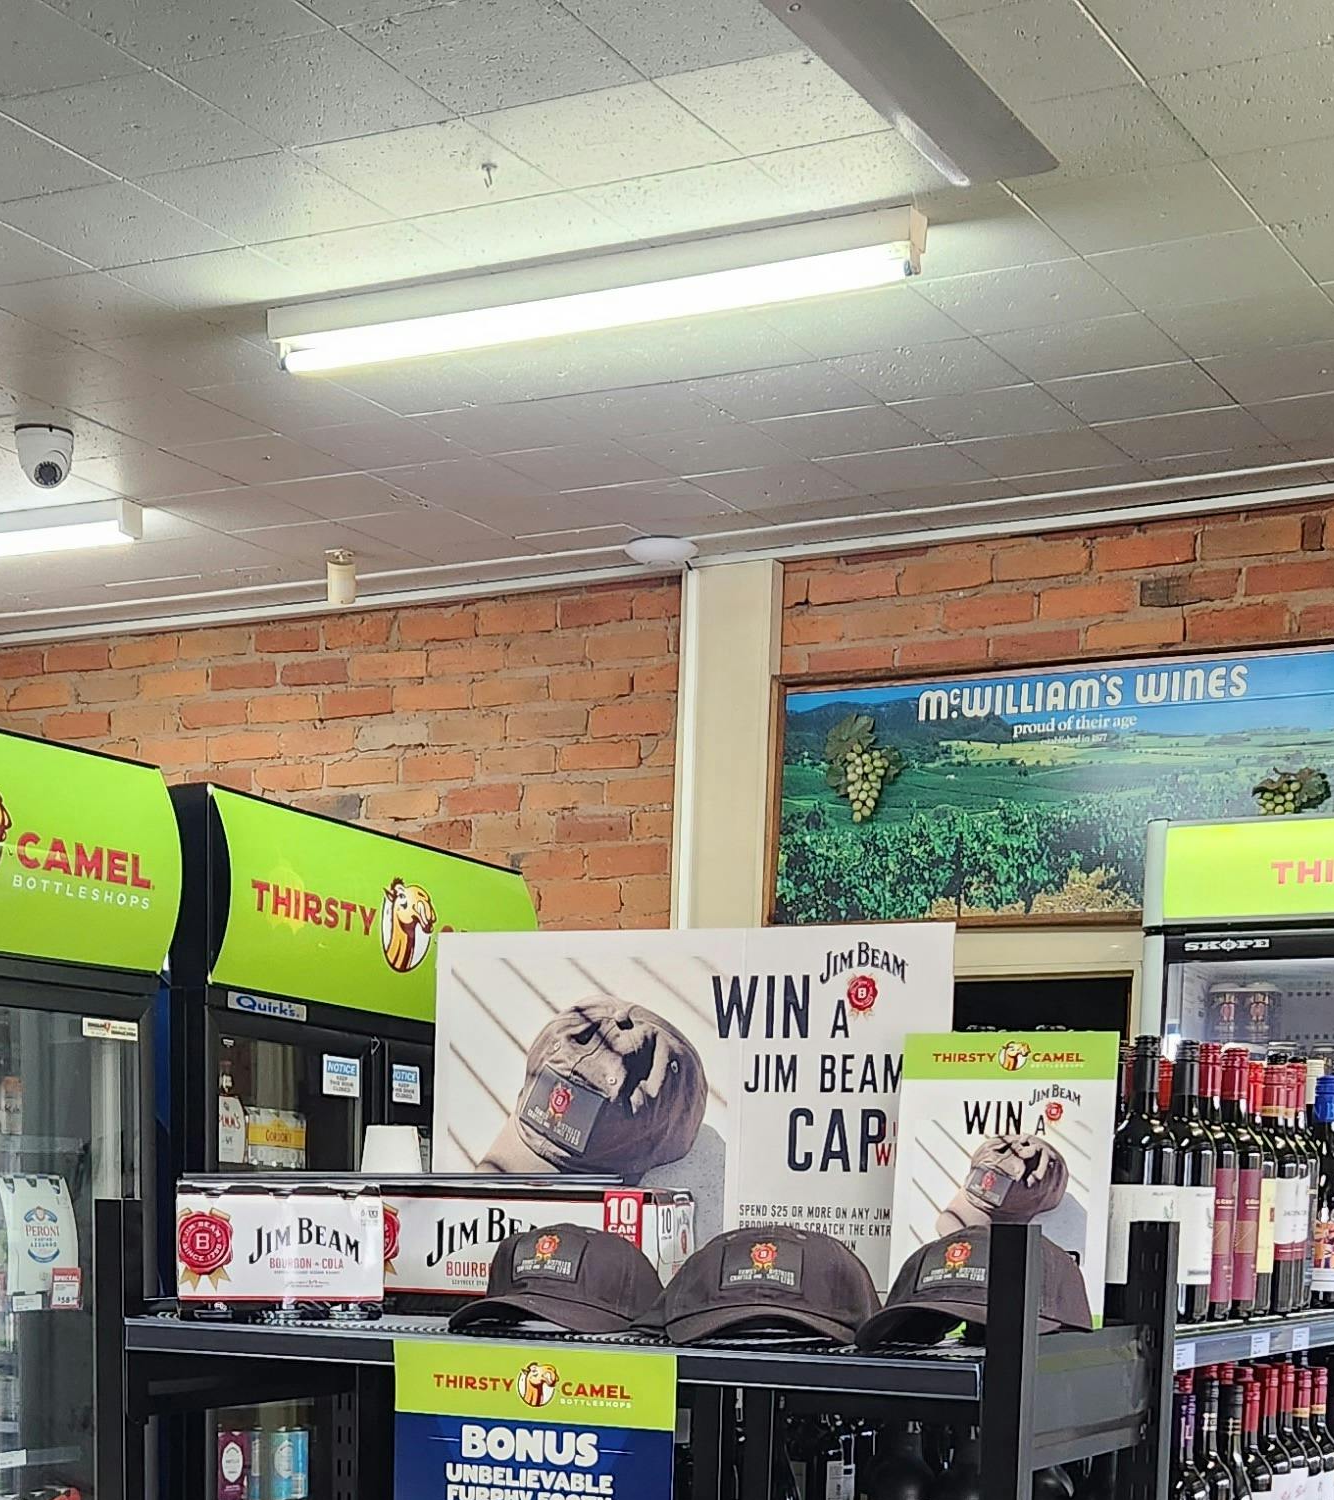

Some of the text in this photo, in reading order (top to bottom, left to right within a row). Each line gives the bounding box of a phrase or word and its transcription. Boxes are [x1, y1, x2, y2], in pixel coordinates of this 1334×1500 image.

[918, 664, 1249, 722] McWILLIAM'S WINES
[1013, 714, 1138, 738] proud of their age
[16, 832, 155, 889] CAMEL
[12, 874, 150, 910] BOTTLESHOPS
[251, 878, 376, 936] THIRSTY
[1184, 938, 1271, 953] SKOPE
[819, 941, 908, 984] JIM BEAM
[712, 974, 849, 1039] WIN A
[327, 1062, 356, 1074] NOTICE
[933, 1052, 1084, 1063] THIRSTY CAMEL
[744, 1054, 904, 1093] JIM BEAM
[1029, 1084, 1081, 1106] JIM BEAM
[963, 1101, 1046, 1135] WIN A
[787, 1107, 888, 1173] CAP
[606, 1197, 639, 1224] 10
[660, 1208, 672, 1235] 10
[739, 1204, 891, 1220] SPEND $25 OR MORE ON ANY JIM
[25, 1225, 60, 1237] PERONI
[195, 1233, 209, 1250] B
[248, 1217, 362, 1264] JIM BEAM
[426, 1217, 479, 1268] JIM
[607, 1224, 636, 1234] CAN
[804, 1222, 864, 1236] SCRATCH THE
[269, 1257, 344, 1269] BOURBON COLA
[433, 1373, 632, 1400] THIRSTY CAMEL
[560, 1398, 632, 1409] BOTTLESHOPS
[461, 1424, 598, 1467] BONUS
[445, 1463, 613, 1495] UNBELIEVABLE
